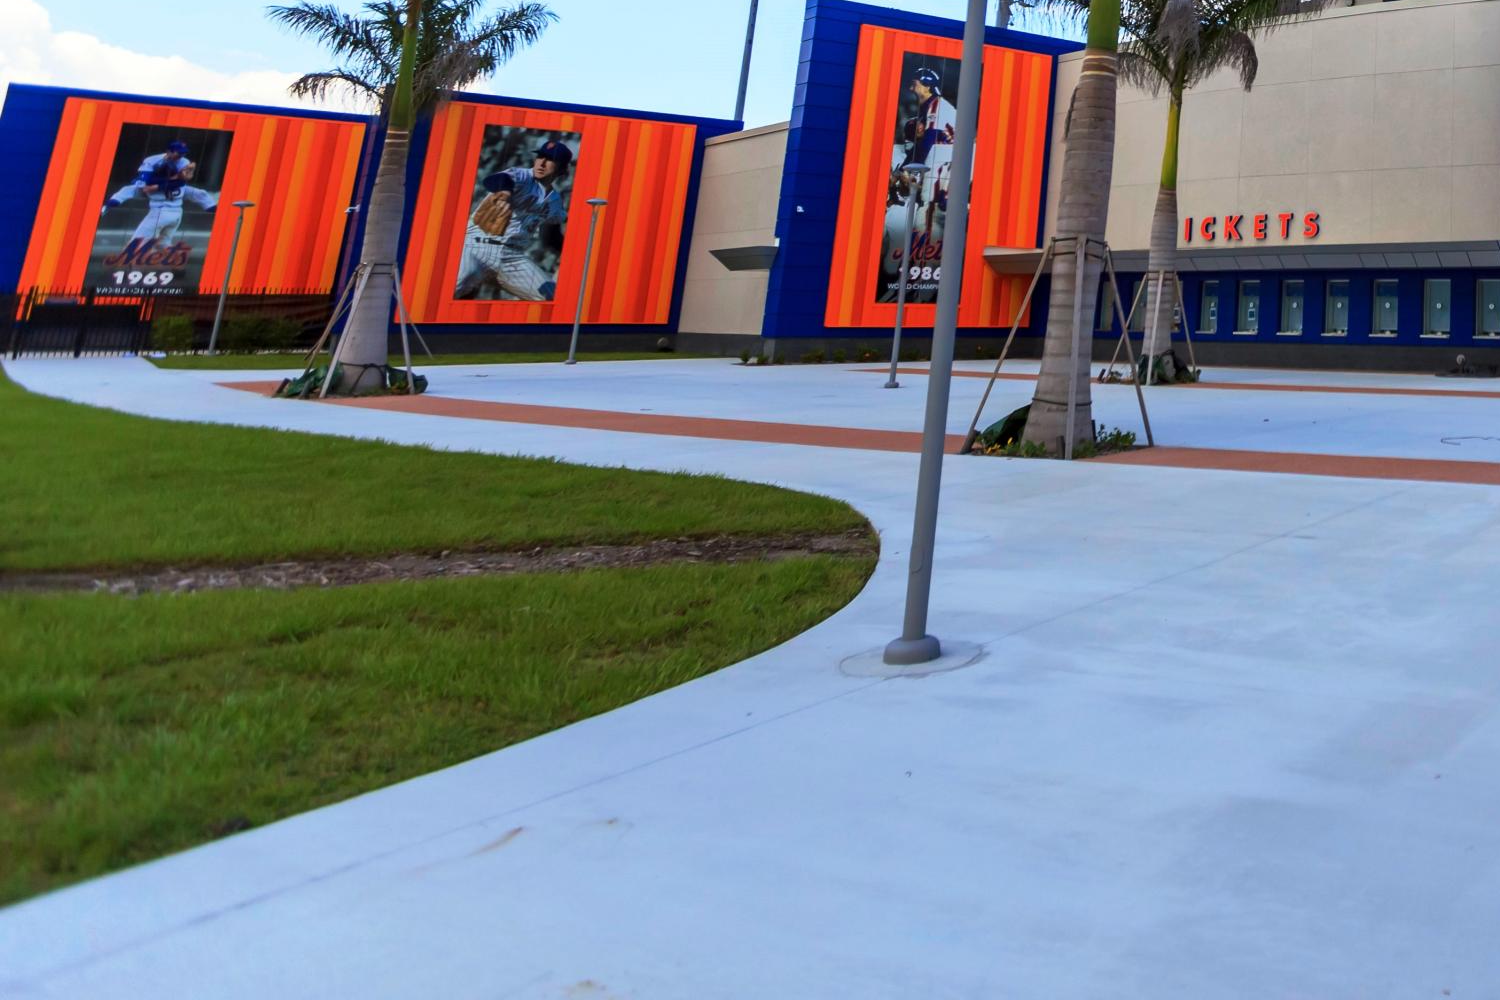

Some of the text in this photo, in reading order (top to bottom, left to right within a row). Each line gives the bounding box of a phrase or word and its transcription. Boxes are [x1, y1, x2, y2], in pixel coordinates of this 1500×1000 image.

[1184, 212, 1320, 243] ICKETS
[103, 237, 193, 268] Mets
[113, 271, 175, 286] 1969
[899, 266, 942, 280] 986
